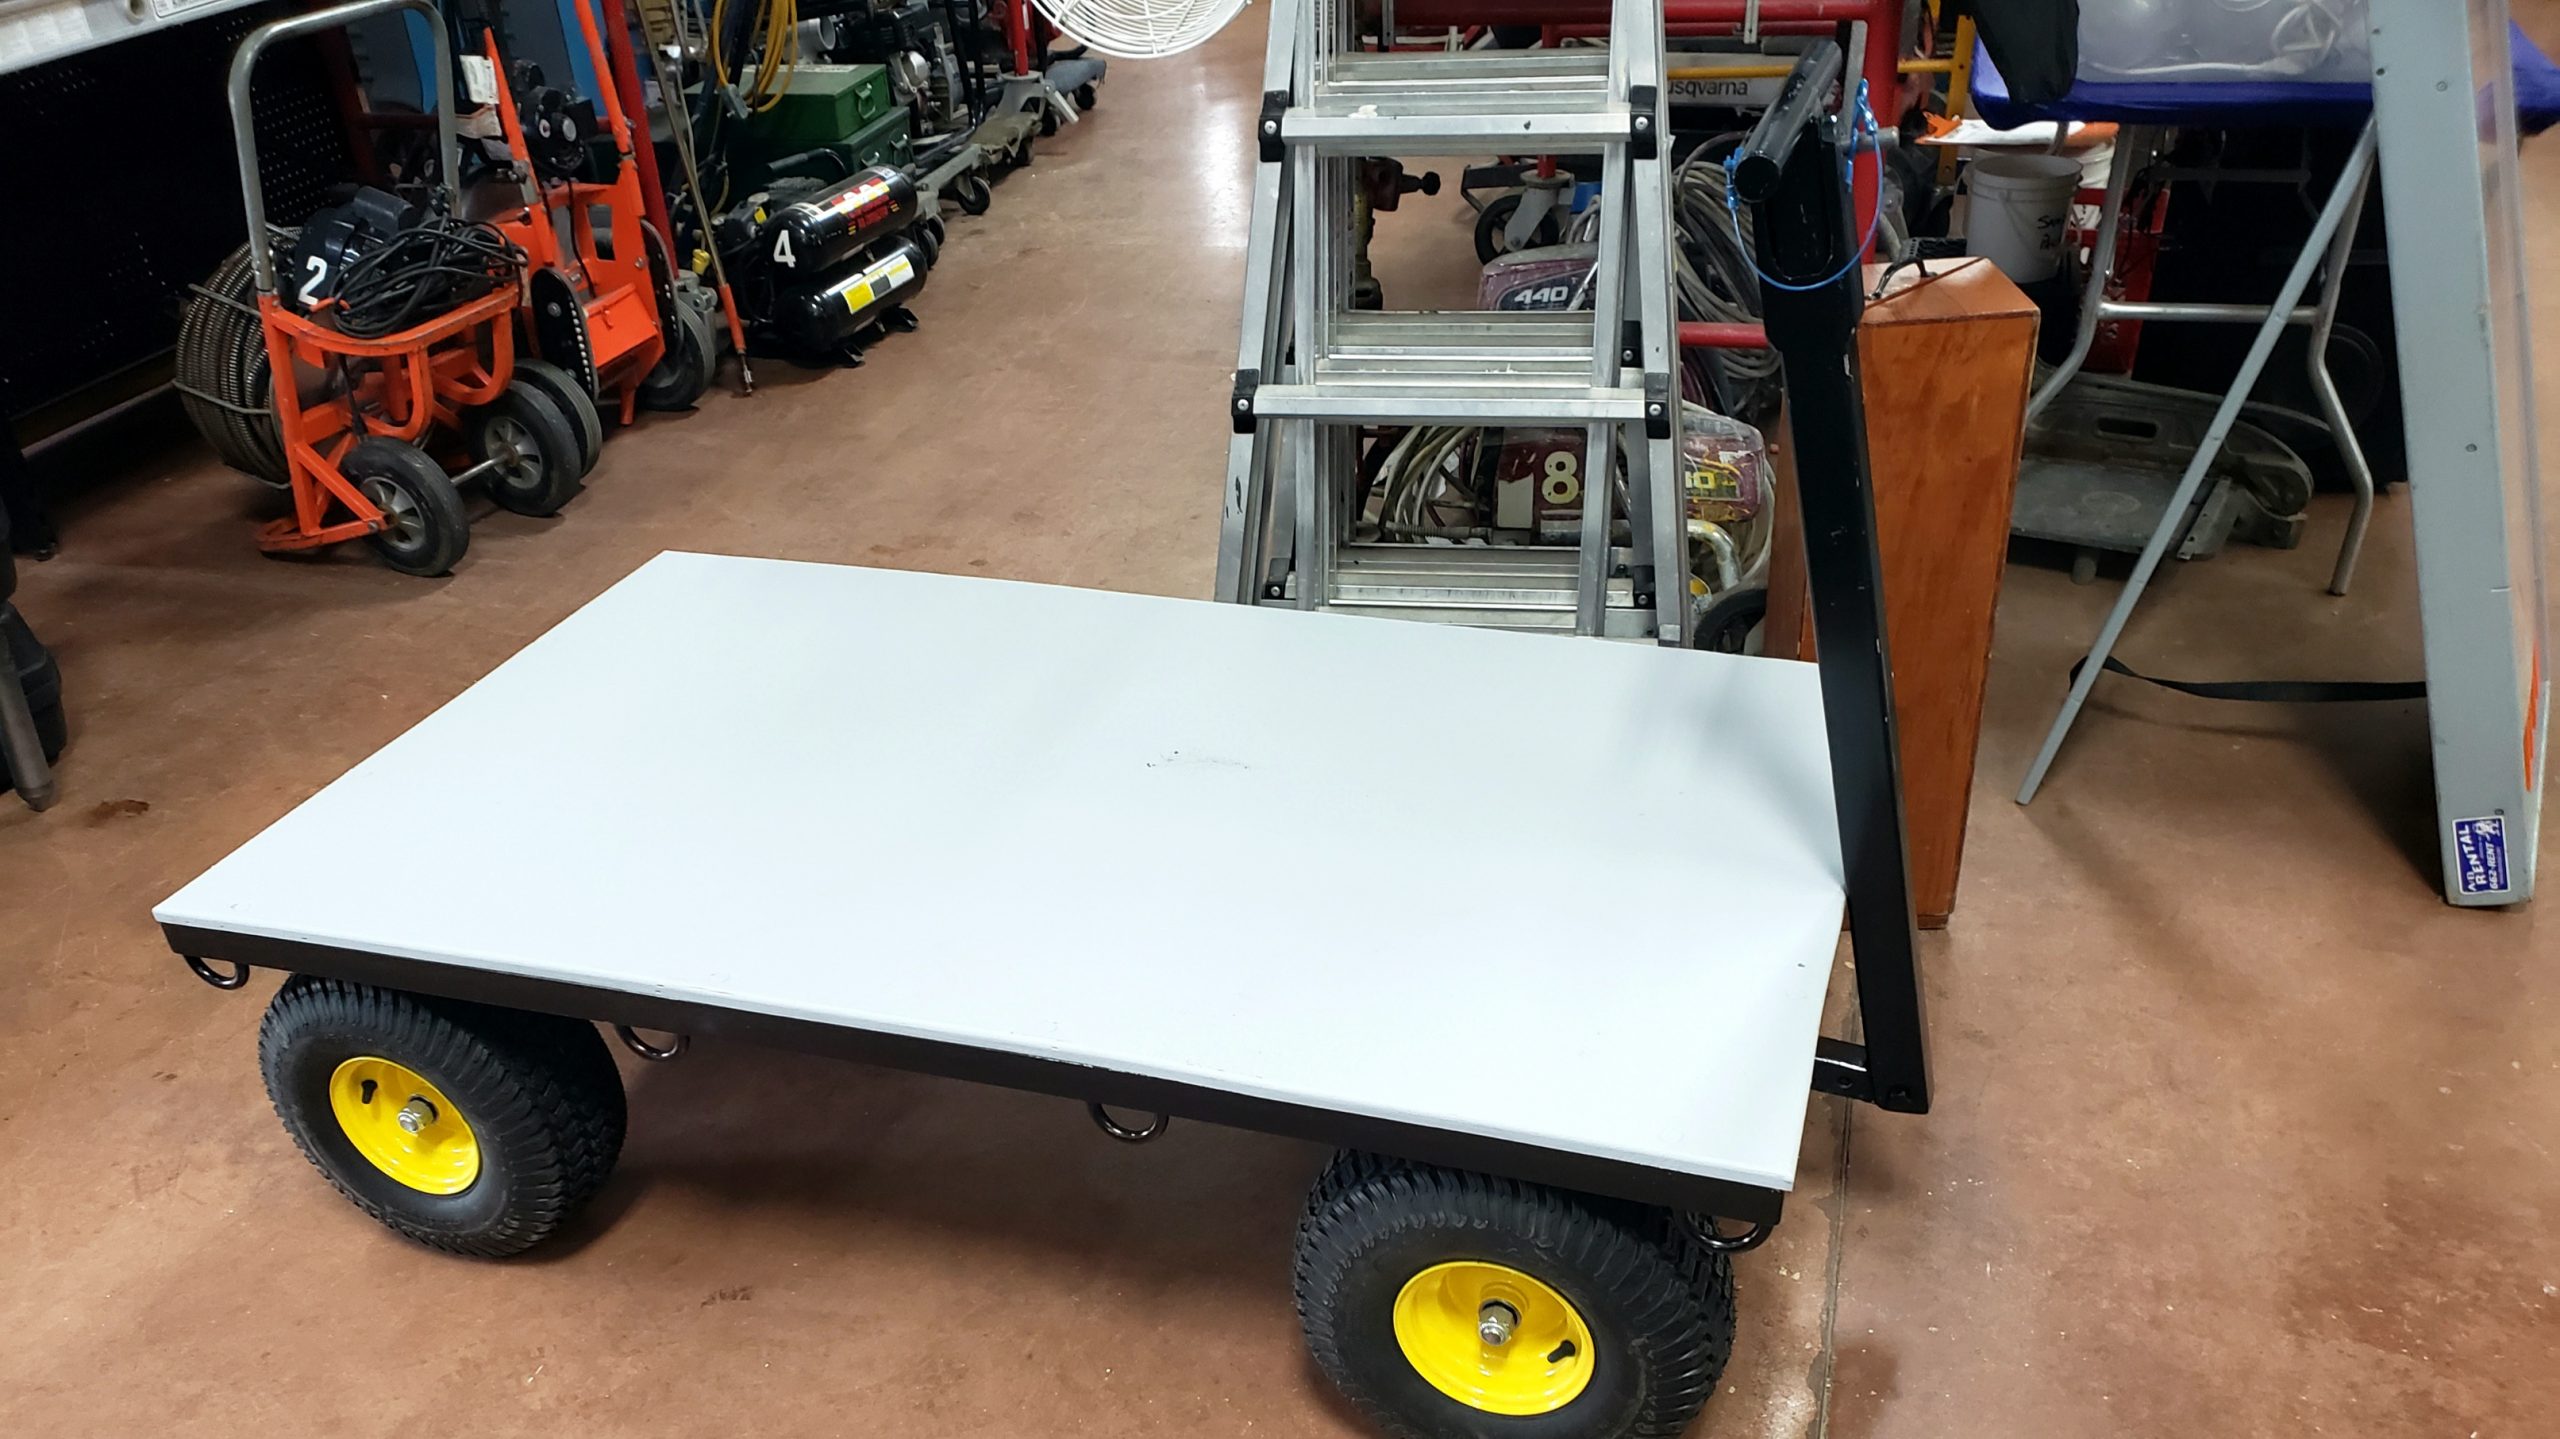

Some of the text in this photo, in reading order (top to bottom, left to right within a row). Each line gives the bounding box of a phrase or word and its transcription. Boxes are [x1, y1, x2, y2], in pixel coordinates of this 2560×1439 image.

[1667, 80, 1748, 97] usqvarna
[773, 229, 796, 267] 4
[298, 255, 327, 305] 2
[1514, 285, 1569, 303] 440
[1541, 450, 1579, 504] 8
[2458, 824, 2488, 885] RENTAL
